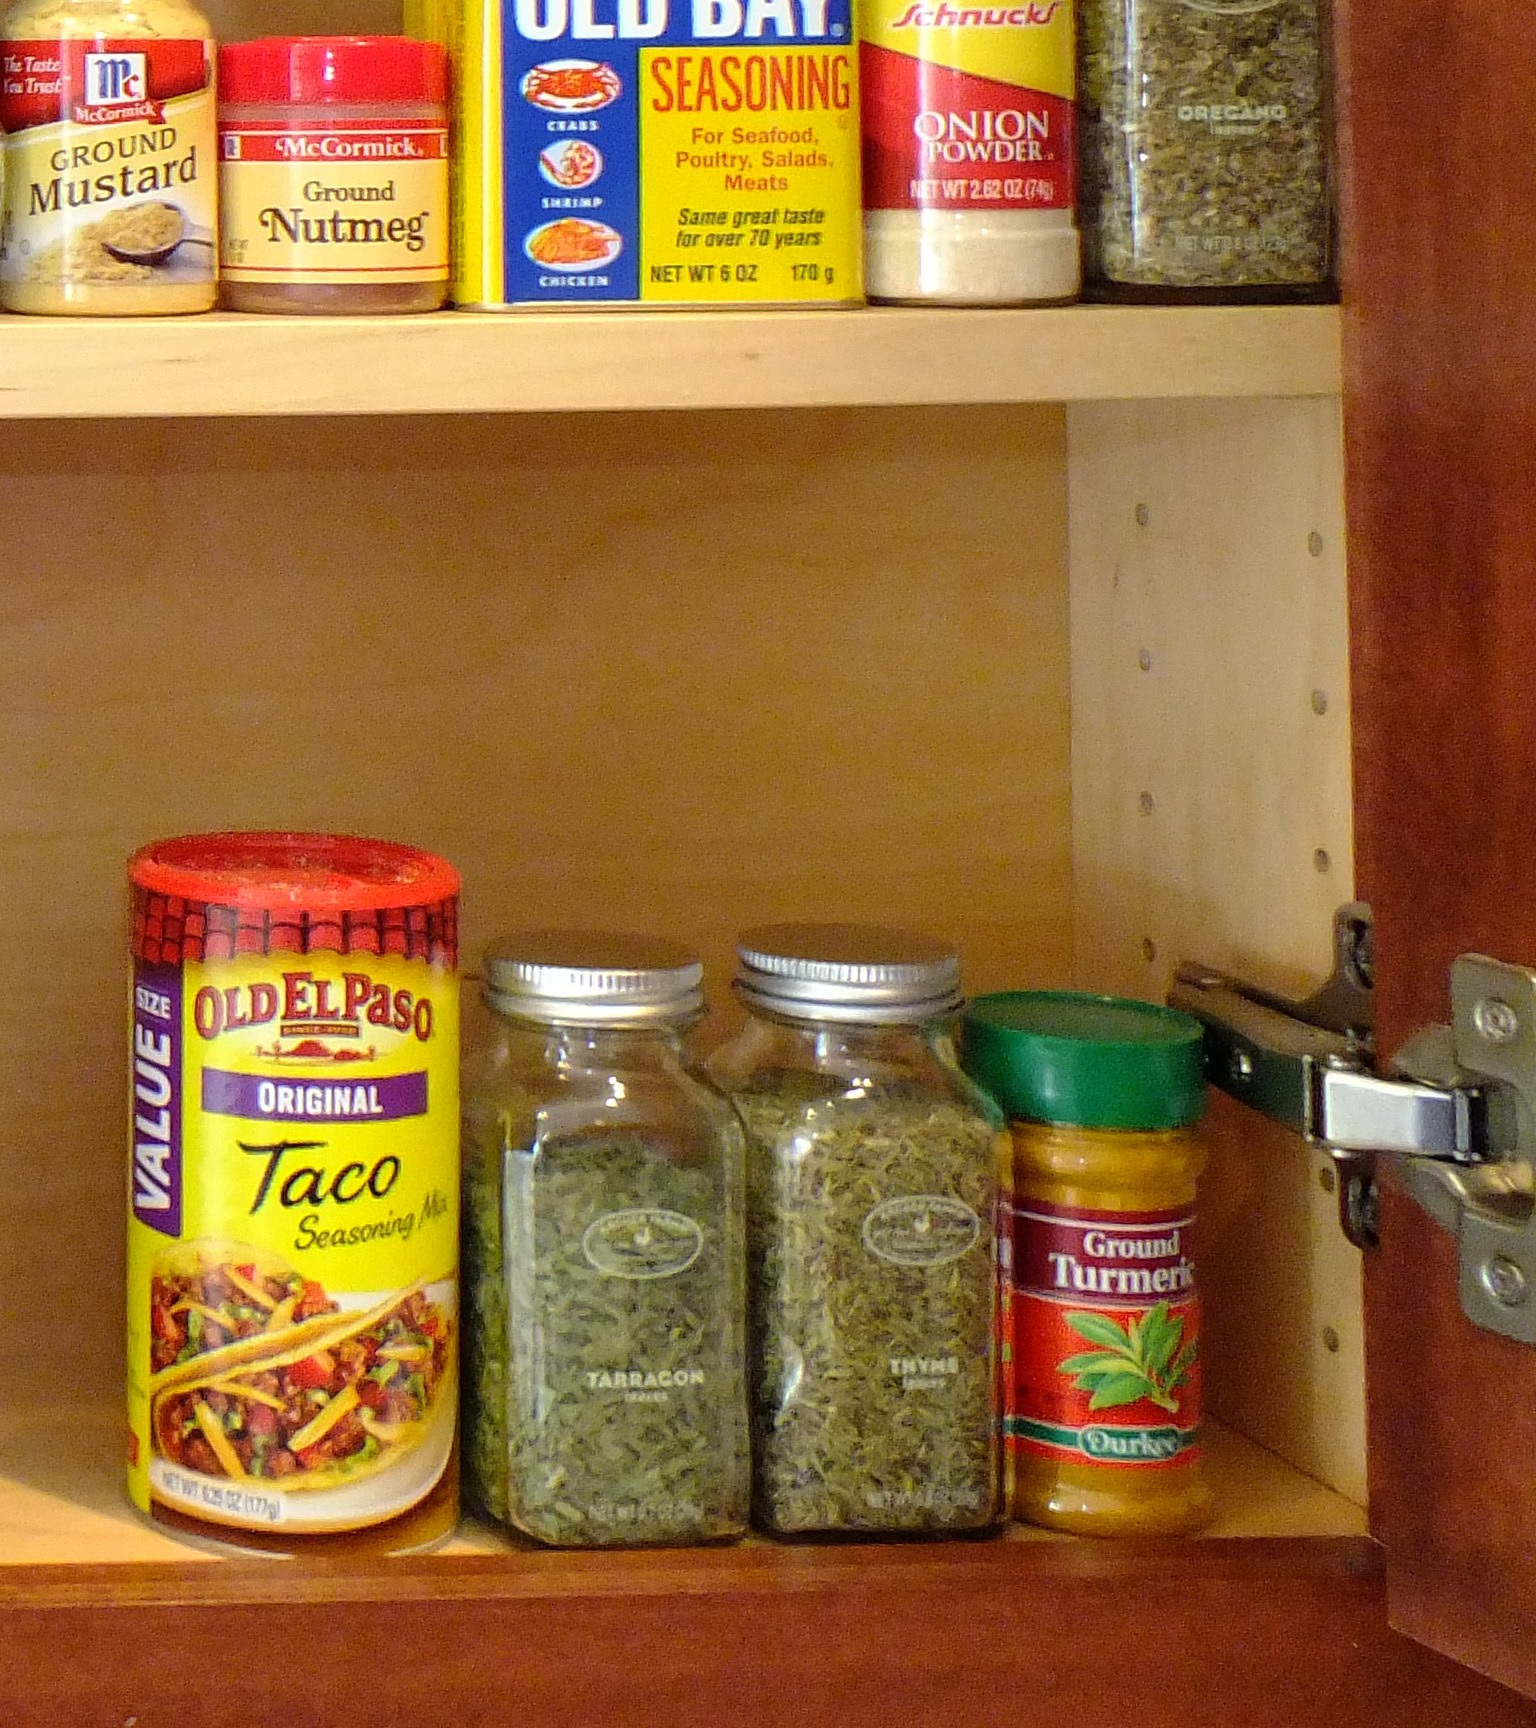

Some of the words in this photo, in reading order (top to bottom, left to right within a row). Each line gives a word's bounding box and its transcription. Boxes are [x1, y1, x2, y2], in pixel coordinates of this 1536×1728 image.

[651, 54, 852, 114] SEASONING
[1177, 105, 1288, 122] OREGANO
[691, 128, 727, 145] For
[732, 127, 820, 146] Seafood,
[914, 110, 1050, 141] ONION
[50, 127, 179, 172] GROUND
[275, 136, 420, 158] McCormick
[928, 141, 1043, 164] POWDER
[675, 151, 753, 171] Poultry,
[762, 151, 835, 169] Salads,
[28, 145, 200, 217] Mustard
[303, 179, 396, 202] Ground
[724, 174, 789, 192] Meats
[259, 207, 430, 252] Nutmeg
[677, 208, 729, 226] Same
[732, 208, 778, 230] great
[782, 208, 826, 225] taste
[675, 230, 701, 248] for
[705, 232, 746, 248] over
[774, 230, 822, 250] years
[650, 265, 684, 284] NET
[687, 265, 715, 284] WT
[257, 1081, 385, 1116] ORIGINAL
[133, 1022, 173, 1212] VALUE
[236, 1139, 403, 1216] Taco
[294, 1212, 415, 1251] Seasoning
[1081, 1229, 1180, 1260] Ground
[887, 1356, 960, 1375] THYME
[585, 1369, 706, 1389] TARRAGON
